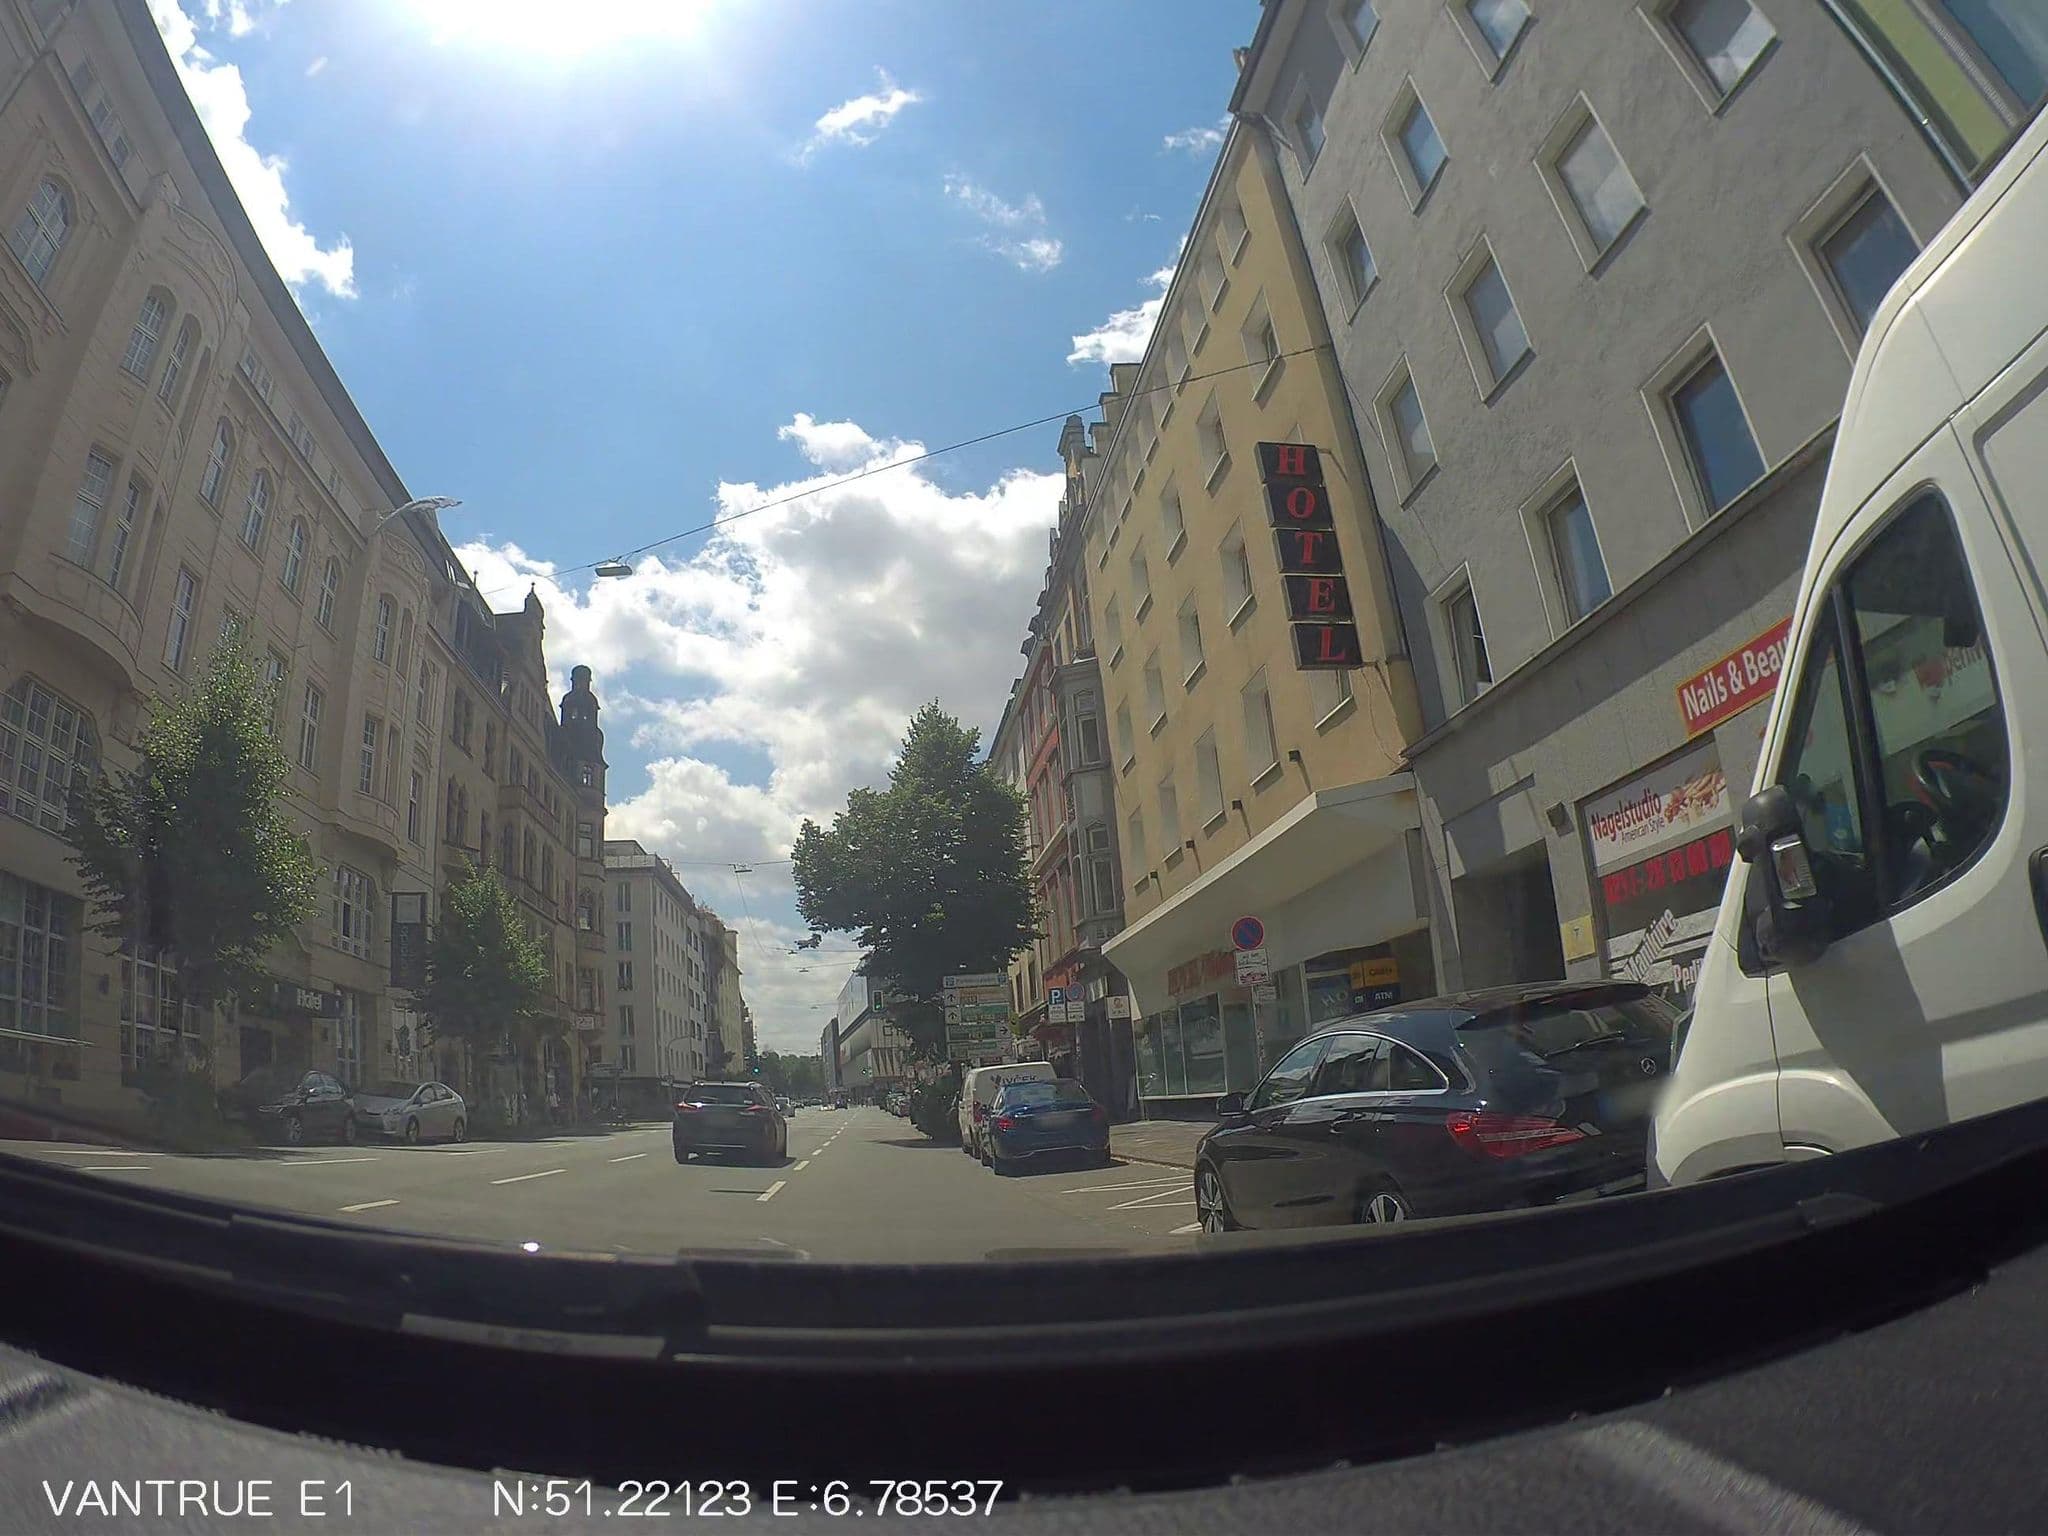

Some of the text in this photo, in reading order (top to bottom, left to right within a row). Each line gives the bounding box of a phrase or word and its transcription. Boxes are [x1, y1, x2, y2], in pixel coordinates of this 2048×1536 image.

[1275, 444, 1346, 662] HOTEL
[1682, 671, 1728, 721] Nails
[1727, 660, 1746, 695] &
[1591, 787, 1662, 842] Nagelstudio
